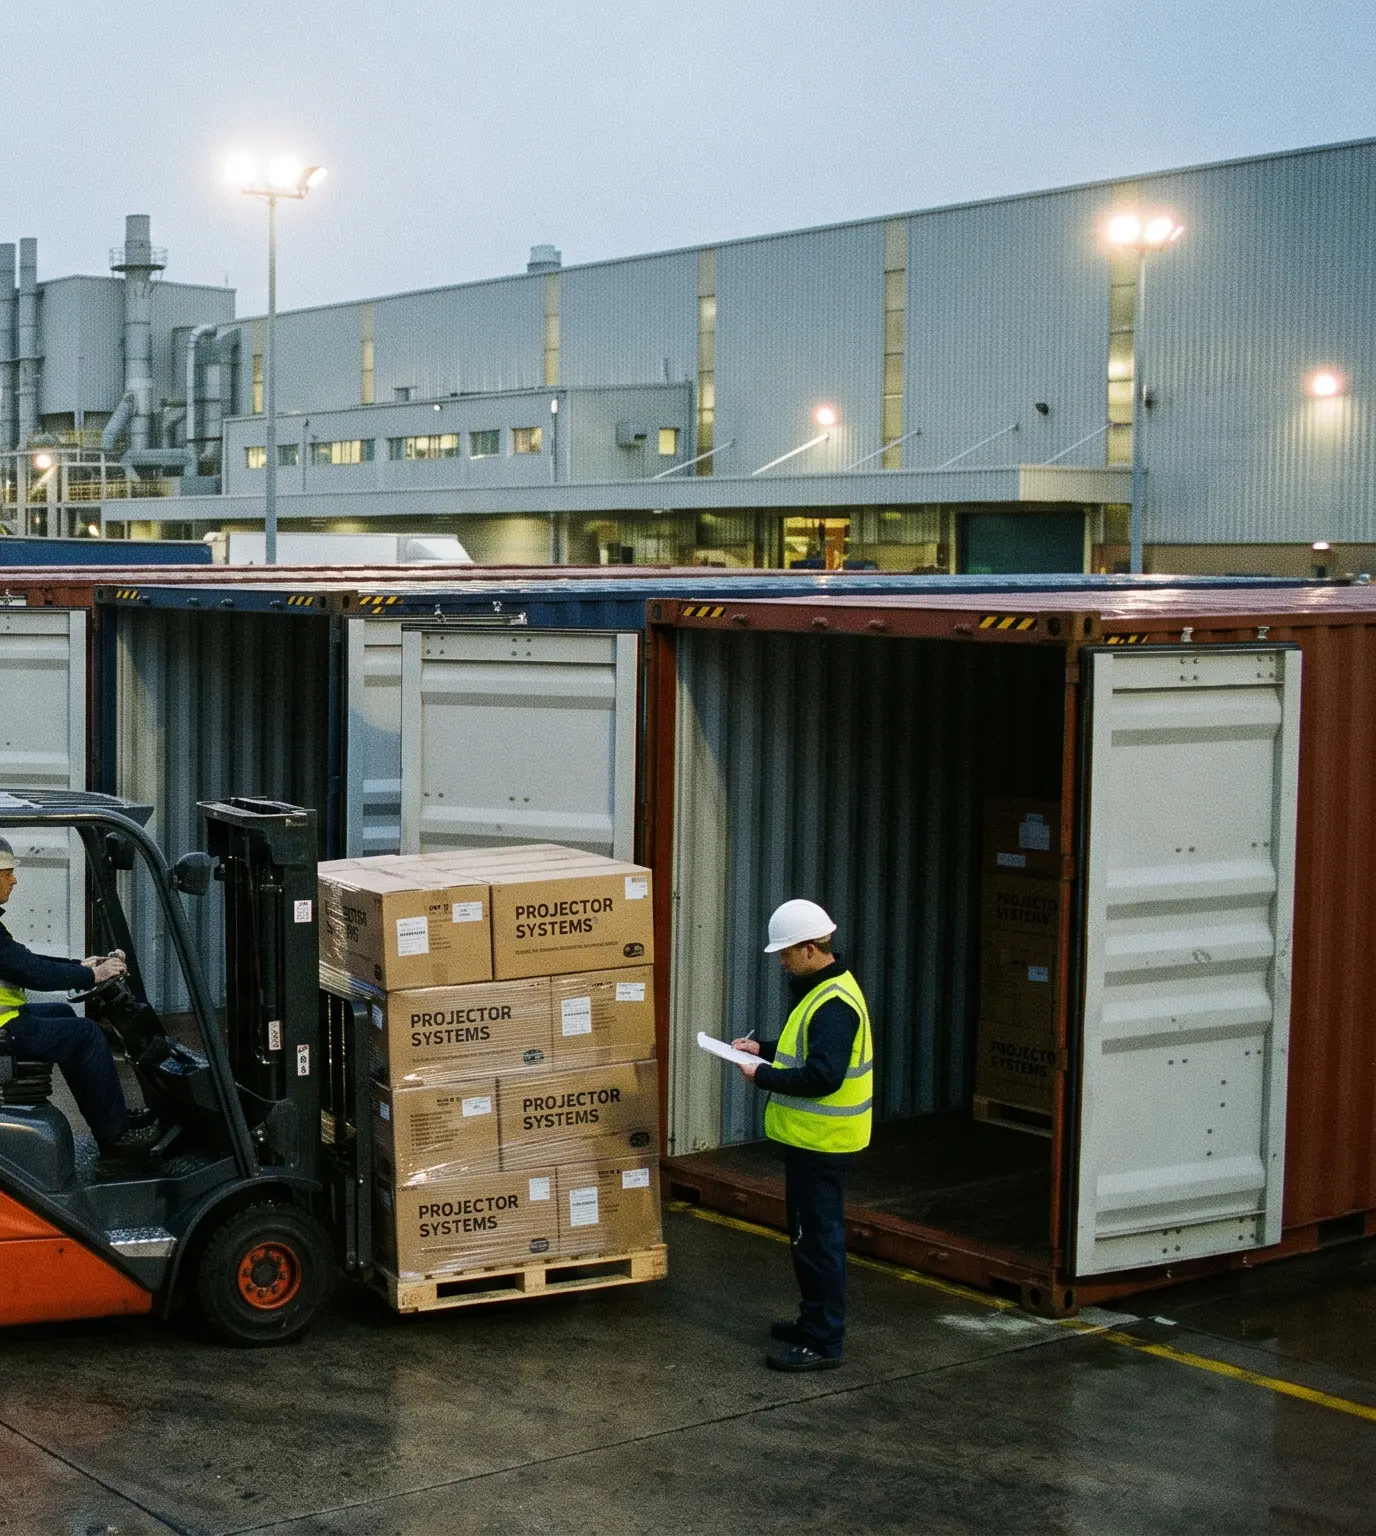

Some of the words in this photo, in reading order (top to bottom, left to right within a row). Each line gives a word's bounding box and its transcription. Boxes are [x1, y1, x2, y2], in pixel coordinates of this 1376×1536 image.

[515, 897, 613, 920] PROJECTOR
[516, 918, 593, 939] SYSTEMS
[411, 1005, 512, 1028] PROJECTOR
[411, 1026, 491, 1047] SYSTEMS
[523, 1088, 621, 1112] PROJECTOR
[523, 1109, 600, 1130] SYSTEMS
[419, 1194, 519, 1219] PROJECTOR
[419, 1215, 498, 1238] SYSTEMS
